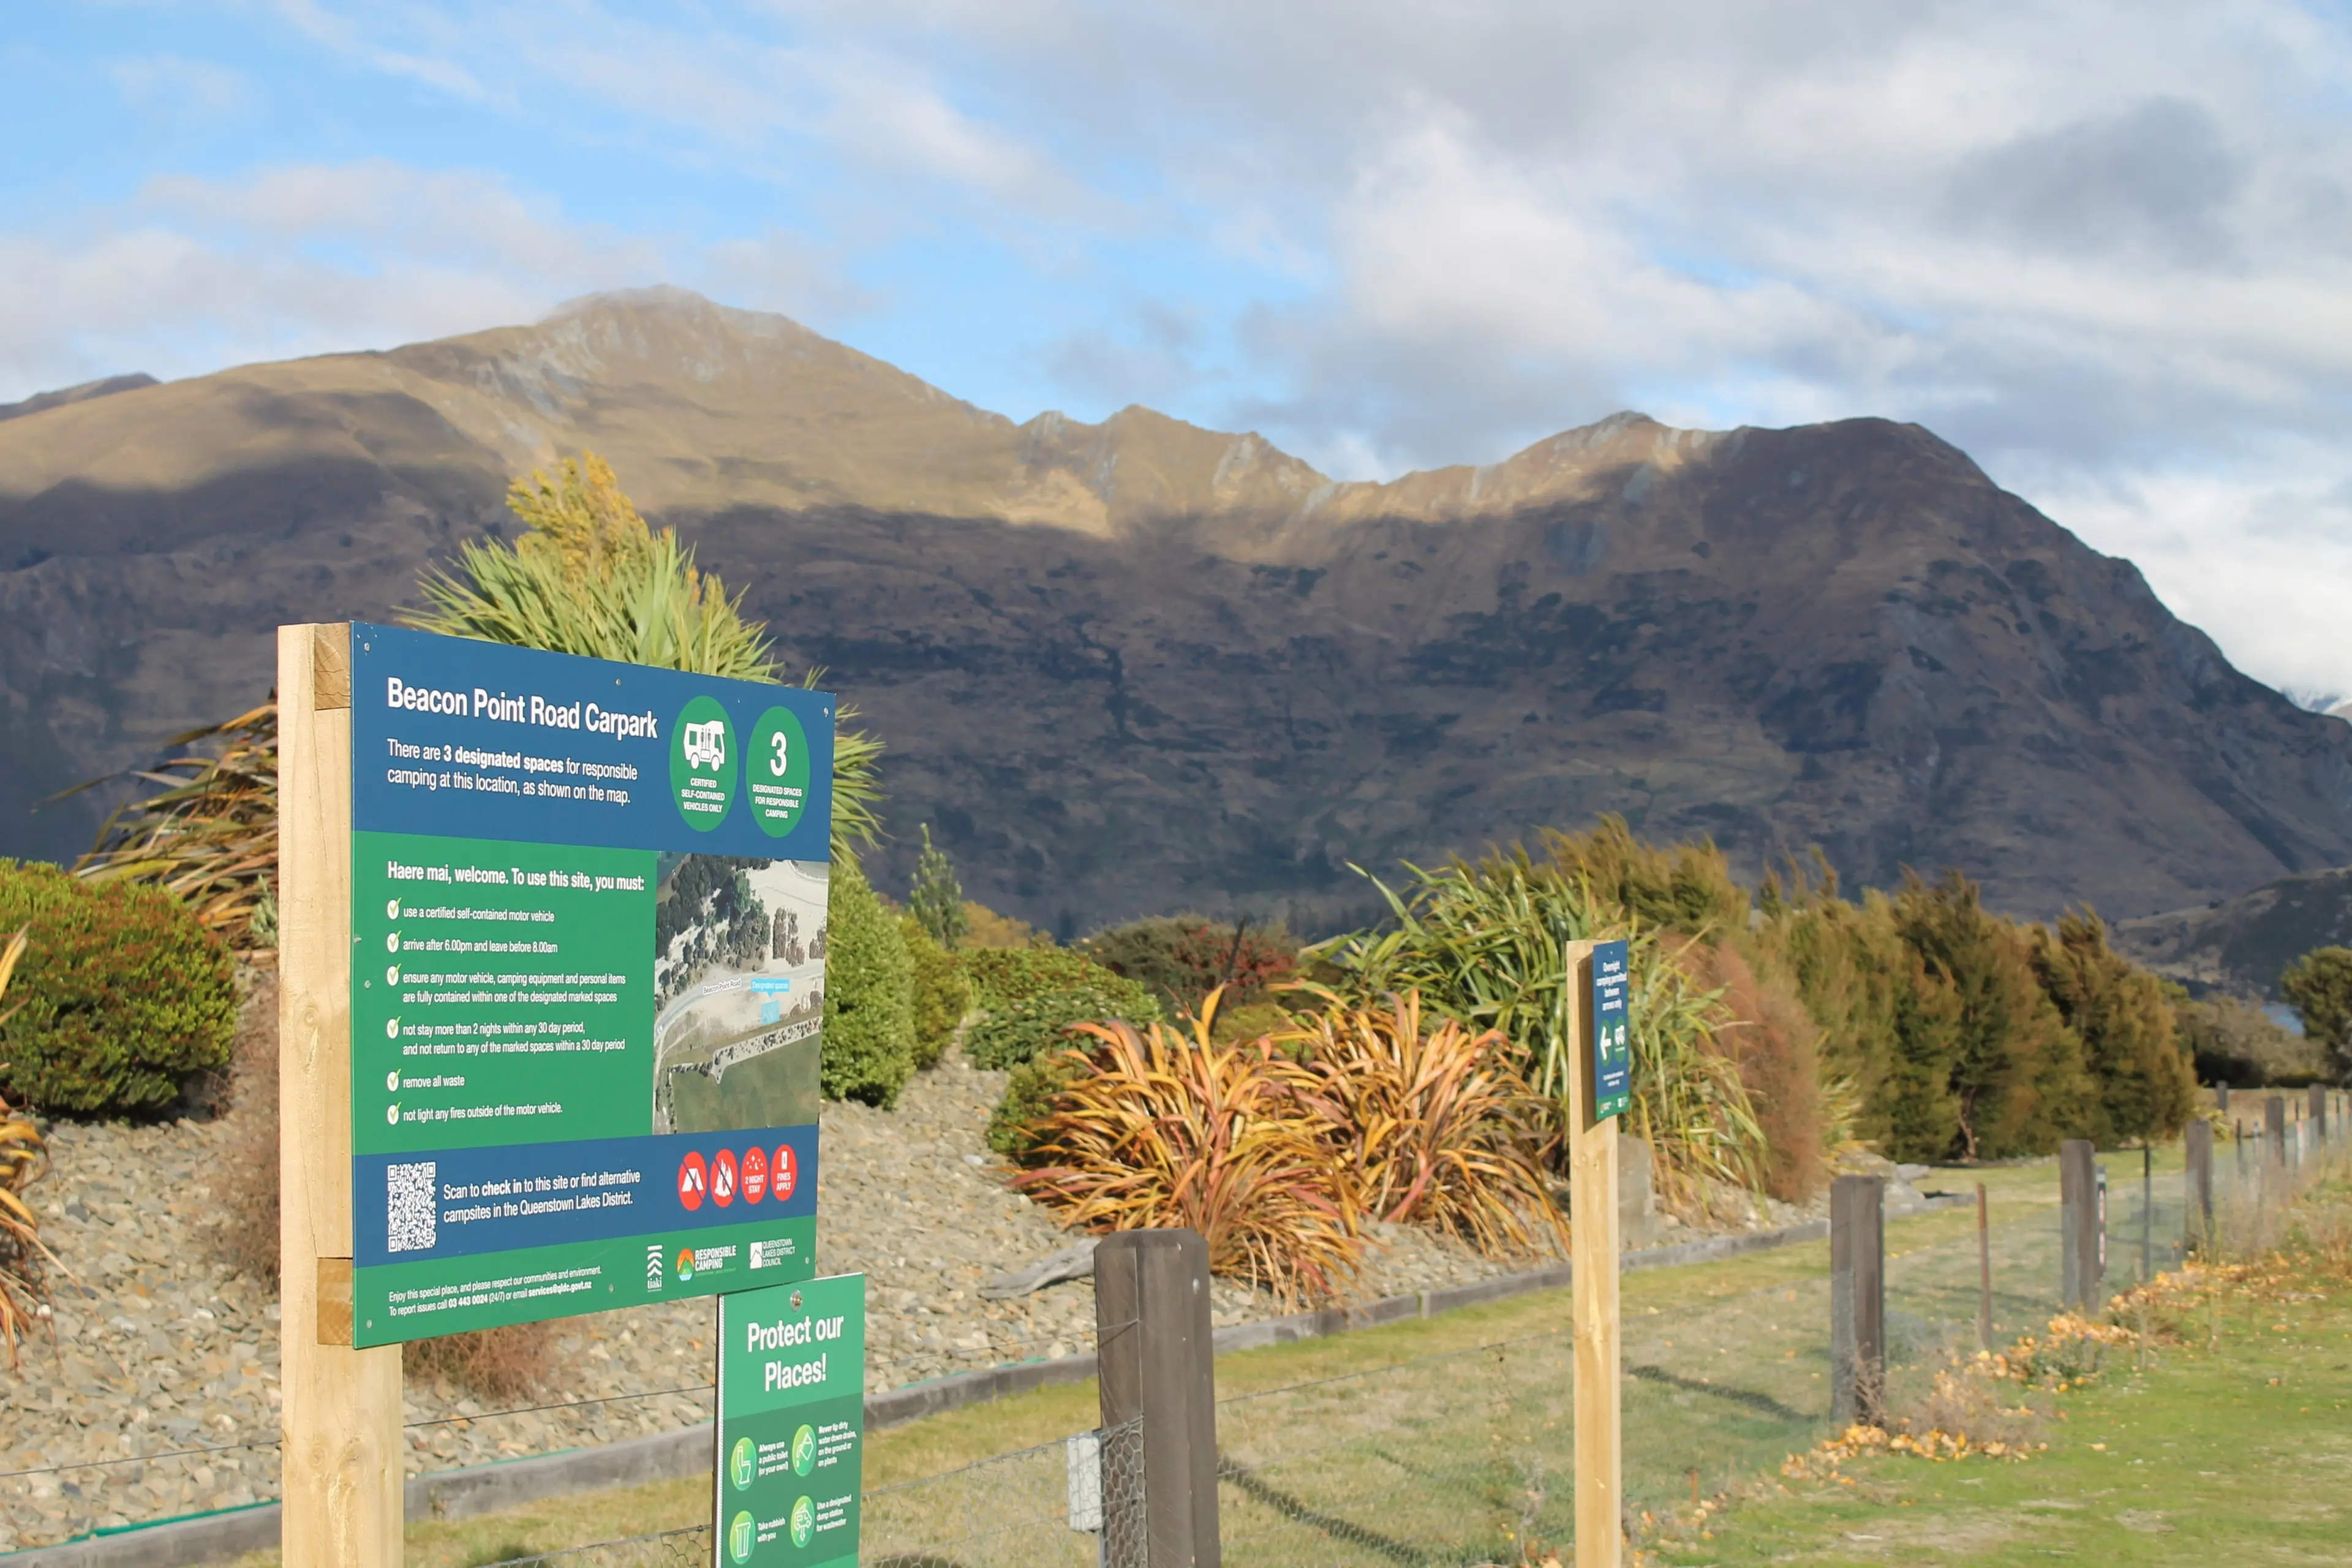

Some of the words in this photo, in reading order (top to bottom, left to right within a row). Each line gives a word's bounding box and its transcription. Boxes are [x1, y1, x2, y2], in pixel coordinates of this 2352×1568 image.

[388, 677, 467, 715] Beacon
[474, 688, 525, 723] Point
[530, 695, 579, 729] Road
[585, 703, 657, 741] Carpark
[386, 738, 420, 758] There
[423, 746, 440, 760] are
[443, 744, 451, 761] 3
[454, 745, 520, 769] designated
[523, 756, 564, 774] spaces
[565, 757, 580, 774] for
[582, 763, 637, 780] responsible
[770, 731, 786, 776] 3
[387, 767, 436, 790] camping
[439, 771, 450, 787] at
[453, 771, 473, 790] this
[476, 773, 519, 796] location,
[522, 782, 535, 795] as
[538, 779, 570, 797] shown
[573, 786, 586, 799] on
[588, 784, 604, 801] the
[606, 789, 630, 806] map.
[690, 778, 717, 788] CERTIFIED
[753, 784, 783, 794] DESIGNATED
[783, 787, 802, 796] SPACES
[681, 789, 725, 801] SELF-CONTAINED
[755, 796, 765, 804] FOR
[766, 797, 798, 807] RESPONSIBLE
[684, 801, 708, 811] VEHICLES
[709, 804, 722, 812] ONLY
[765, 809, 788, 818] CAMPING
[388, 861, 424, 880] Haere
[426, 864, 451, 884] mai,
[454, 865, 508, 884] welcome.
[511, 867, 524, 884] To
[527, 872, 546, 886] use
[548, 870, 568, 887] this
[570, 871, 593, 891] site,
[595, 876, 614, 892] you
[616, 875, 644, 891] must:
[403, 908, 418, 918] use
[418, 908, 424, 918] a
[425, 906, 455, 919] certified
[456, 907, 507, 920] self-contained
[508, 910, 530, 921] motor
[530, 910, 554, 922] vehicle
[402, 938, 424, 950] arrive
[426, 938, 443, 951] after
[444, 939, 472, 954] 6.00pm
[473, 940, 488, 951] and
[489, 940, 508, 952] leave
[508, 940, 532, 952] before
[532, 941, 557, 953] 8.00am
[402, 973, 429, 983] ensure
[429, 974, 444, 986] any
[445, 972, 467, 983] motor
[469, 971, 496, 985] vehicle,
[497, 972, 527, 986] camping
[528, 973, 564, 986] equipment
[565, 973, 578, 984] and
[579, 973, 607, 986] personal
[608, 973, 625, 984] items
[752, 982, 774, 990] Designated
[402, 1024, 416, 1035] not
[417, 1023, 434, 1038] stay
[434, 1025, 454, 1035] more
[454, 1023, 472, 1035] than
[472, 1022, 478, 1035] 2
[479, 1022, 501, 1037] nights
[502, 1022, 523, 1033] within
[524, 1024, 537, 1036] any
[538, 1022, 548, 1033] 30
[548, 1022, 561, 1036] day
[562, 1021, 585, 1035] period,
[403, 1078, 431, 1088] remove
[432, 1075, 441, 1087] all
[442, 1075, 465, 1087] waste
[403, 1109, 416, 1121] not
[417, 1108, 434, 1123] light
[435, 1110, 449, 1122] any
[450, 1107, 466, 1118] fires
[467, 1105, 494, 1118] outside
[494, 1104, 502, 1116] of
[503, 1104, 515, 1115] the
[516, 1103, 537, 1115] motor
[537, 1102, 562, 1114] vehicle.
[443, 1184, 467, 1200] Scan
[469, 1183, 480, 1197] to
[481, 1179, 511, 1196] check
[513, 1178, 522, 1193] in
[524, 1178, 533, 1192] to
[535, 1176, 551, 1191] this
[552, 1175, 568, 1189] site
[570, 1177, 579, 1188] or
[581, 1172, 597, 1187] find
[598, 1169, 640, 1186] alternative
[748, 1174, 764, 1183] NIGHT
[748, 1185, 760, 1193] STAY
[443, 1204, 491, 1224] campsites
[493, 1202, 501, 1218] in
[503, 1201, 518, 1216] the
[519, 1197, 574, 1215] Queenstown
[576, 1194, 600, 1209] Lakes
[602, 1191, 633, 1207] District.
[763, 1238, 792, 1249] QUEENSTOWN
[695, 1245, 736, 1260] RESPONSIBLE
[763, 1248, 776, 1258] LAKES
[776, 1246, 795, 1256] DISTRICT
[695, 1257, 722, 1271] CAMPING
[763, 1257, 781, 1267] COUNCIL
[389, 1291, 406, 1303] Enjoy
[407, 1289, 418, 1299] this
[419, 1286, 440, 1300] special
[441, 1284, 459, 1297] place,
[459, 1281, 471, 1292] and
[472, 1281, 491, 1292] please
[491, 1276, 513, 1289] respect
[513, 1276, 522, 1285] our
[523, 1271, 557, 1284] communities
[557, 1268, 568, 1279] and
[568, 1265, 601, 1278] environment.
[647, 1276, 662, 1289] tiaki
[389, 1306, 397, 1316] To
[398, 1304, 416, 1316] report
[417, 1302, 436, 1312] issues
[436, 1299, 447, 1310] call
[448, 1297, 457, 1308] 03
[458, 1295, 471, 1306] 443
[471, 1293, 488, 1305] 0024
[489, 1291, 505, 1304] (24/7)
[512, 1288, 527, 1299] email
[748, 1316, 811, 1352] Protect
[815, 1316, 844, 1341] our
[765, 1352, 826, 1392] Places!
